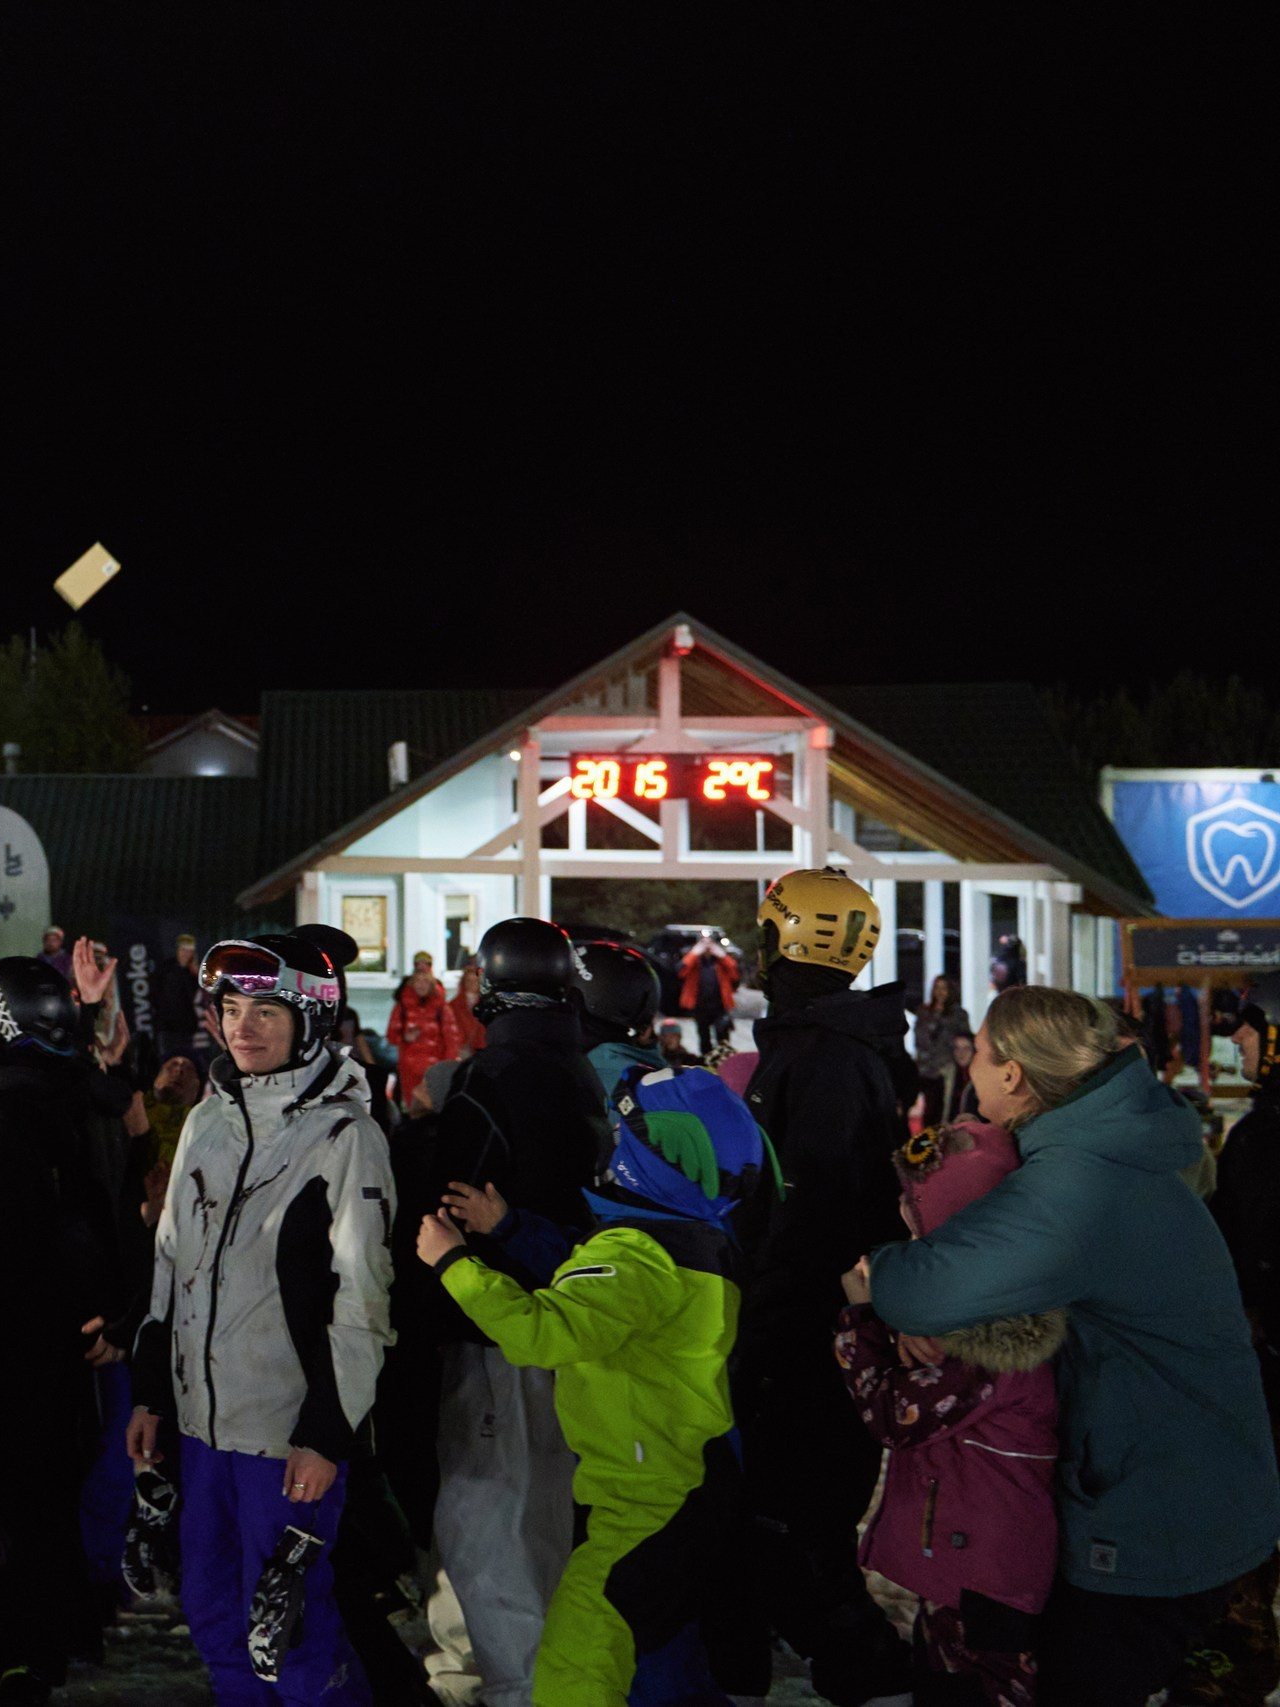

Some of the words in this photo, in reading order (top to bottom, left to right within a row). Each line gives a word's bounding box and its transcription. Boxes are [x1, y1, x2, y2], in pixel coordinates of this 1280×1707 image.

[571, 760, 619, 799] 20
[634, 760, 668, 799] 15
[125, 943, 154, 1040] nvoke
